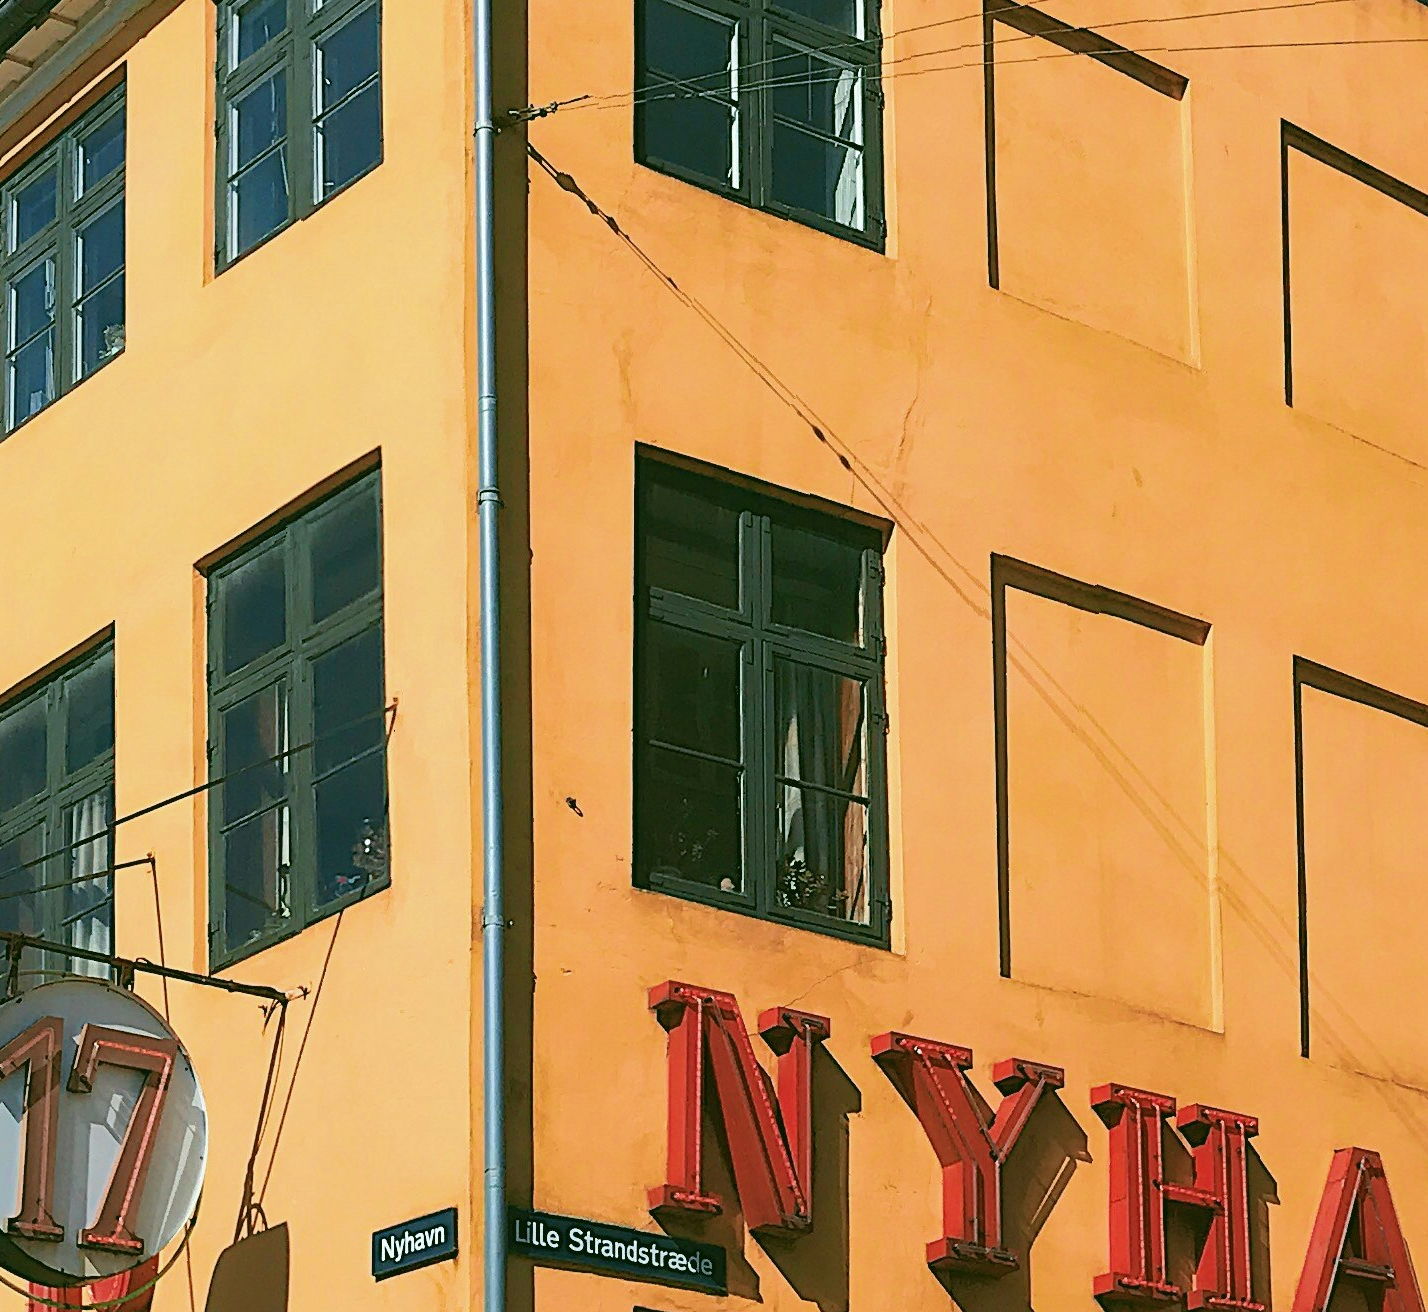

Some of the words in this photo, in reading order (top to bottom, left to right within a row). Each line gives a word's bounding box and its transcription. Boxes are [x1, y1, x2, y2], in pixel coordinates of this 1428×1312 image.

[380, 1224, 446, 1263] Nyhavn
[514, 1219, 560, 1248] Lille
[568, 1227, 713, 1276] Strandstræde
